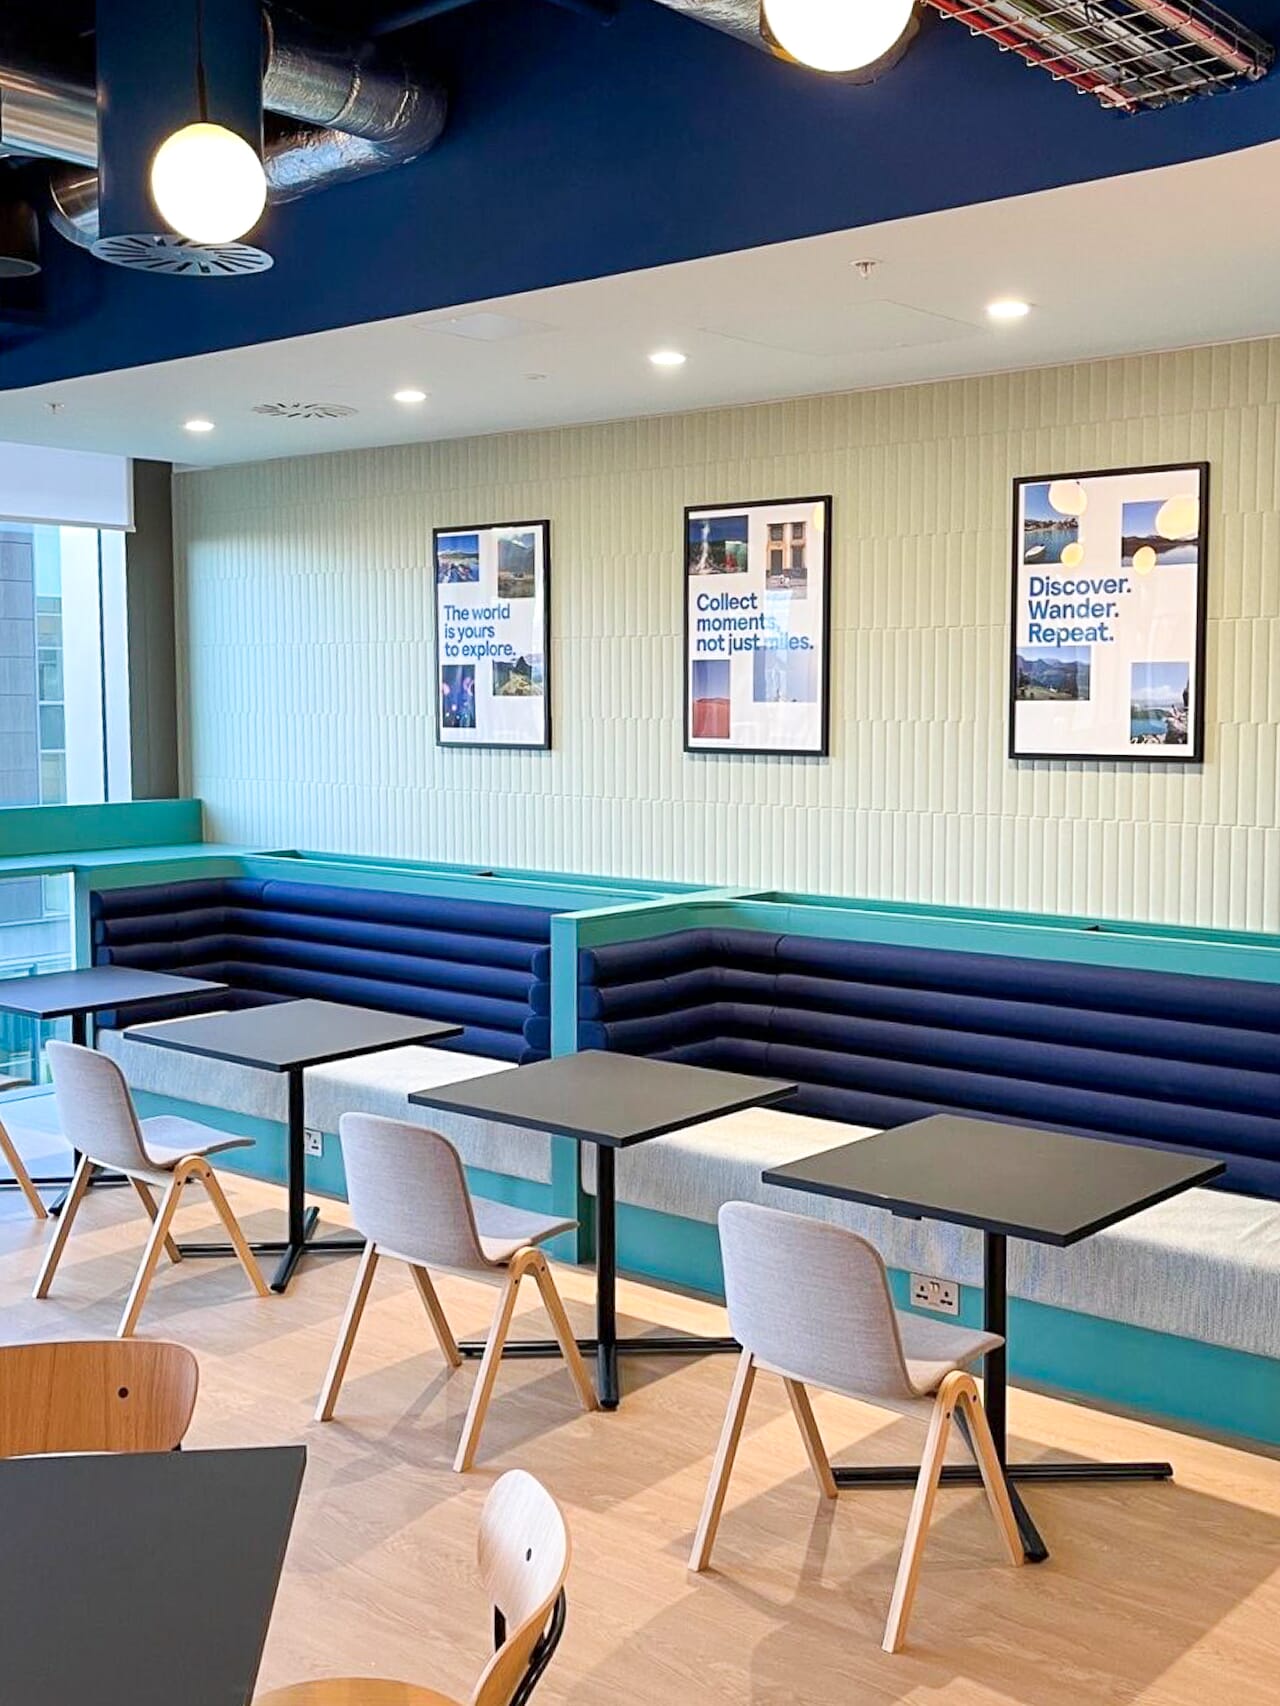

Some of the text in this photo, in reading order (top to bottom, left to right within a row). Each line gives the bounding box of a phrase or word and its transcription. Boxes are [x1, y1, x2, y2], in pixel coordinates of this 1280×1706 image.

[1029, 575, 1132, 597] Discover.
[444, 603, 510, 620] The world
[696, 592, 758, 612] Collect
[1028, 598, 1120, 620] Wander.
[444, 624, 495, 643] is yours
[1028, 621, 1114, 647] Repeat.
[445, 641, 516, 660] to explore.
[696, 633, 814, 656] not just miles.
